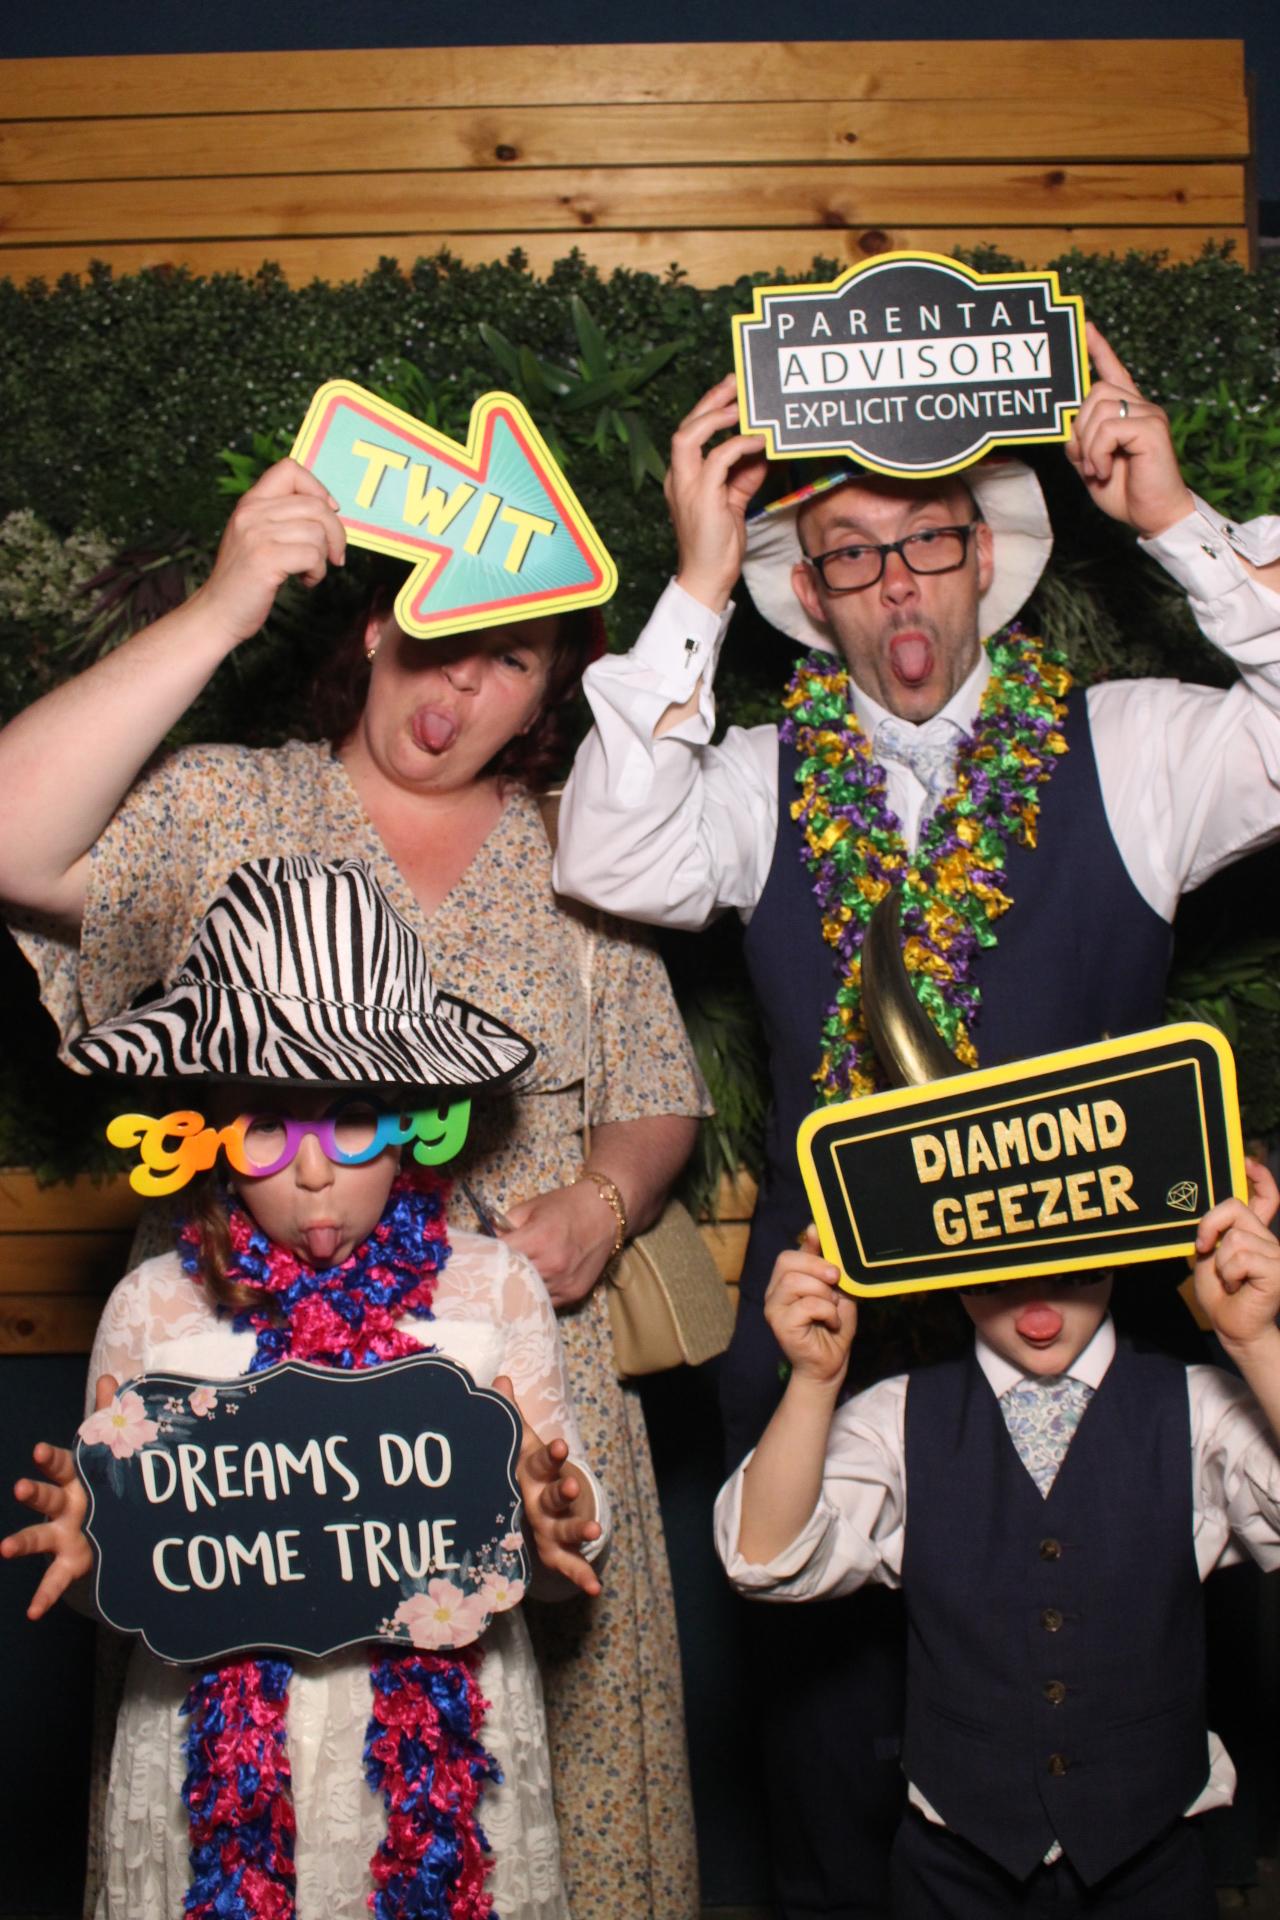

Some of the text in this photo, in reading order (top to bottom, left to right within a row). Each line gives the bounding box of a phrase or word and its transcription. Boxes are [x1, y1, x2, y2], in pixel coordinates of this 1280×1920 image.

[778, 300, 1046, 340] PARENTAL
[784, 340, 1047, 386] ADVISORY
[785, 388, 1053, 430] EXPLICIT CONTENT
[351, 439, 556, 574] TWIT
[911, 1099, 1127, 1184] DIAMOND
[932, 1165, 1140, 1246] GEEZER
[140, 1431, 453, 1513] DREAMS DO
[152, 1518, 461, 1593] COME TRUE
